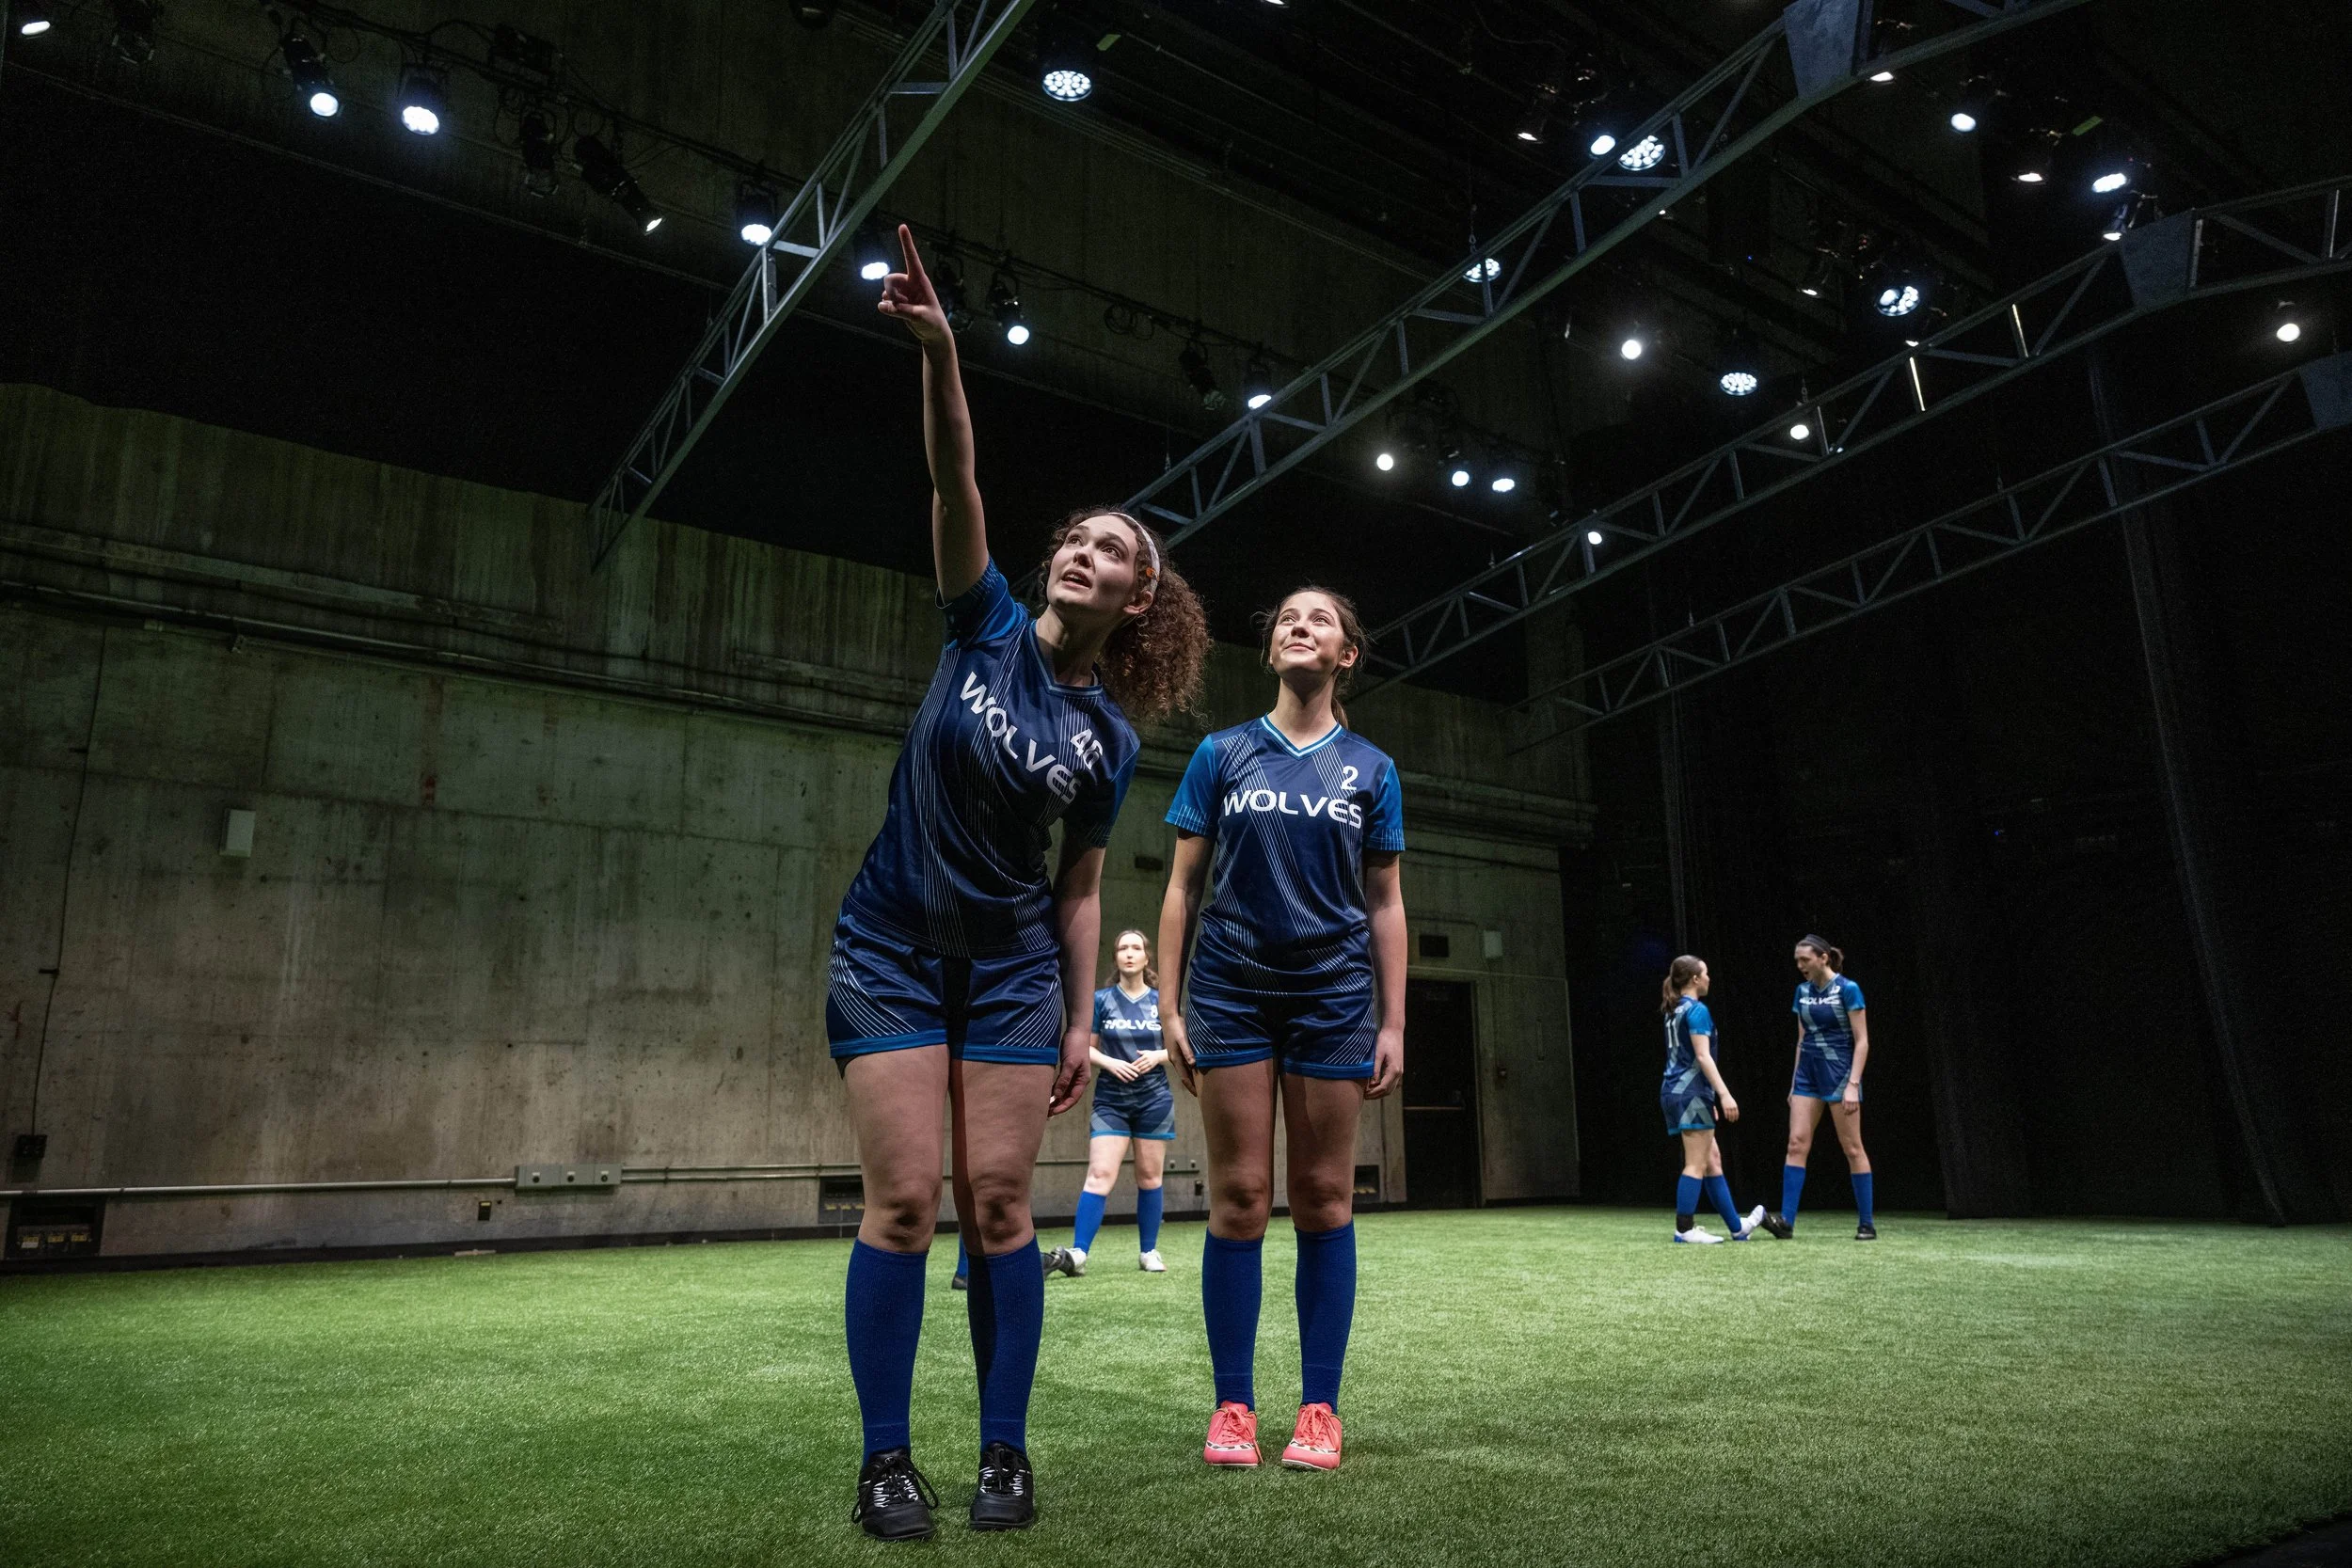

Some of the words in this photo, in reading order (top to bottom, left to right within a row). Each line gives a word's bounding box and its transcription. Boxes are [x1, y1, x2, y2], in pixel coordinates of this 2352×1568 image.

[960, 672, 1082, 804] WOLVES
[1071, 728, 1104, 770] 46
[1340, 765, 1359, 790] 2
[1223, 789, 1362, 830] WOLVES
[1103, 1019, 1163, 1032] WOLVES
[1665, 1017, 1680, 1049] 11
